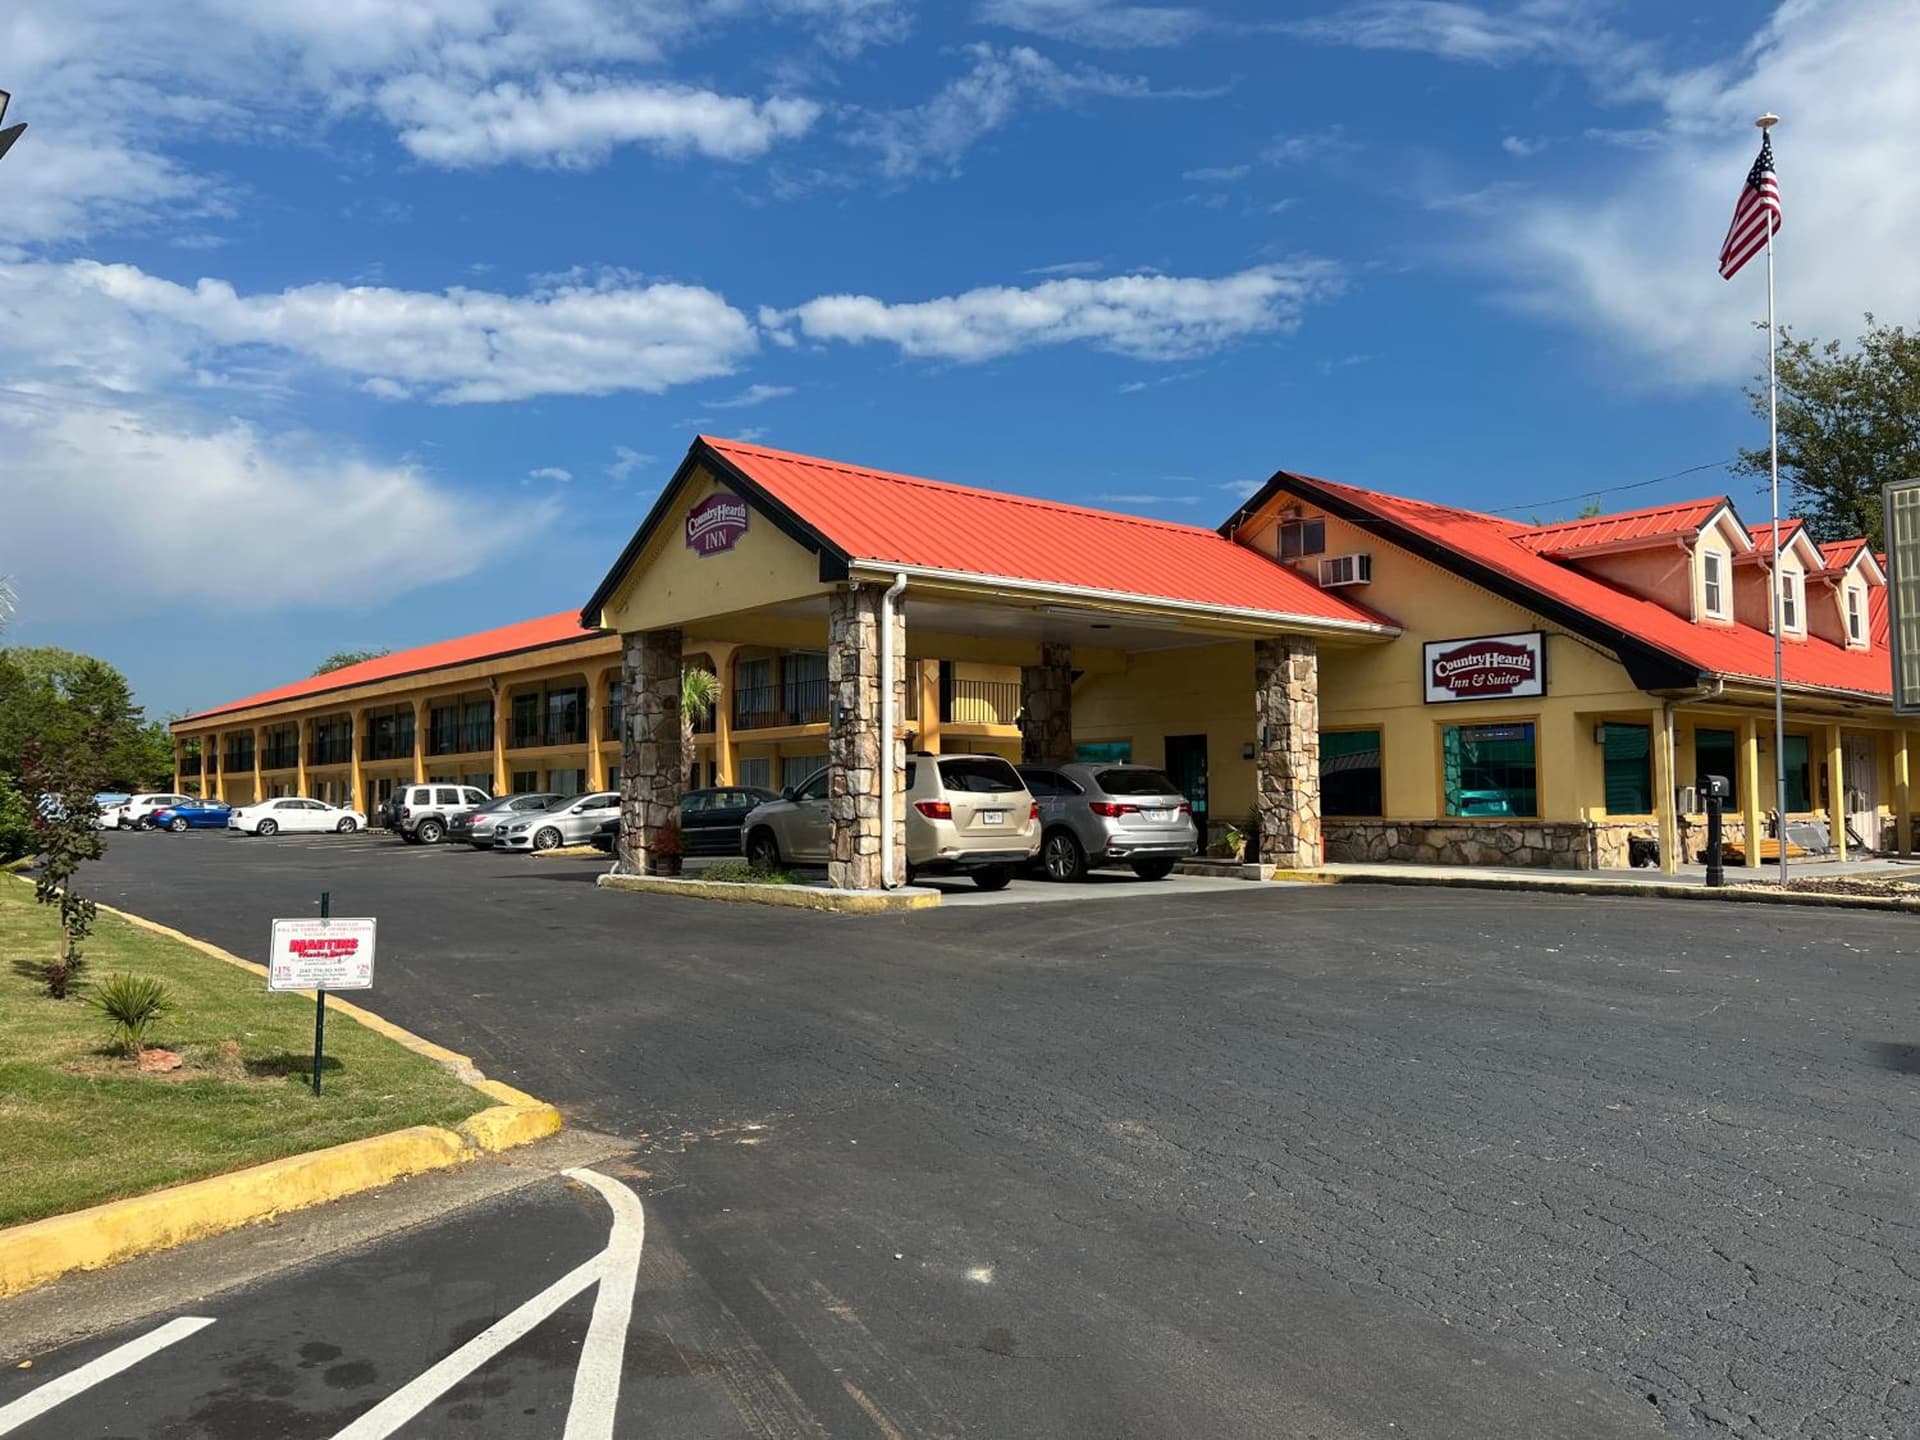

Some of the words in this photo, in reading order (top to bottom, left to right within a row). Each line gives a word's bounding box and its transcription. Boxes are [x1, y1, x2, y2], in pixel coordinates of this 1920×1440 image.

[705, 528, 727, 550] INN
[1449, 677, 1469, 689] Inn
[1472, 674, 1485, 687] &
[1487, 672, 1521, 686] Suites
